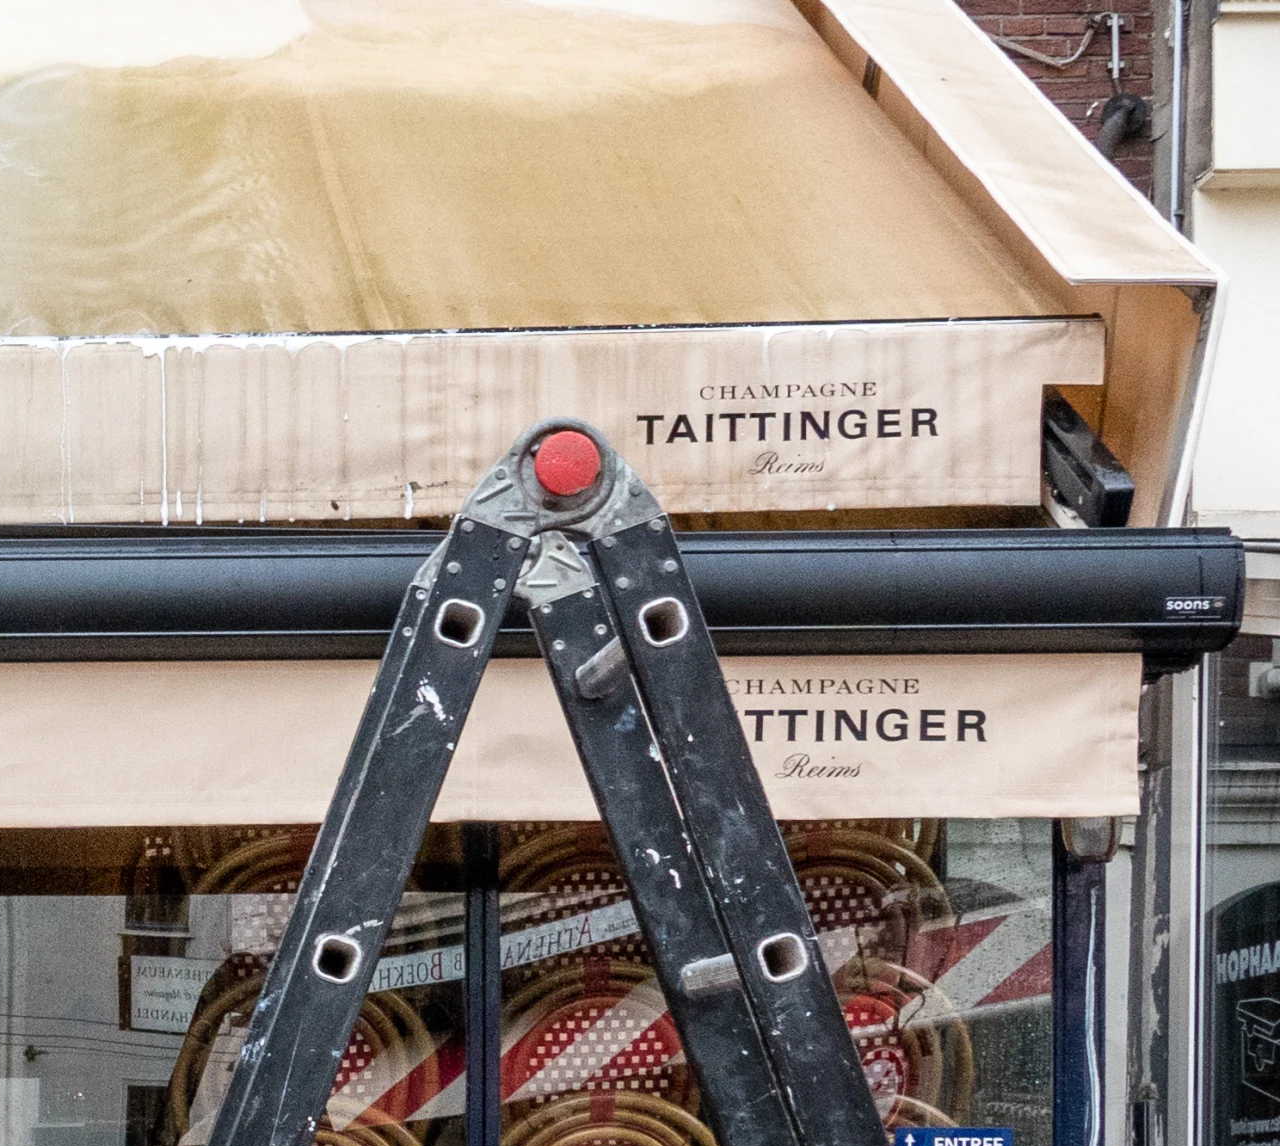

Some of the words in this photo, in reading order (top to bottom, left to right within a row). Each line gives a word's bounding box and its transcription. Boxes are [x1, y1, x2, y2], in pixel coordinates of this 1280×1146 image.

[700, 382, 877, 400] CHAMPAGNE
[637, 408, 939, 445] TAITTINGER
[748, 451, 825, 475] Reims
[1166, 600, 1210, 611] soons
[724, 678, 920, 695] CHAMPAGNE
[734, 708, 988, 743] TTINGER
[775, 752, 864, 779] Reims
